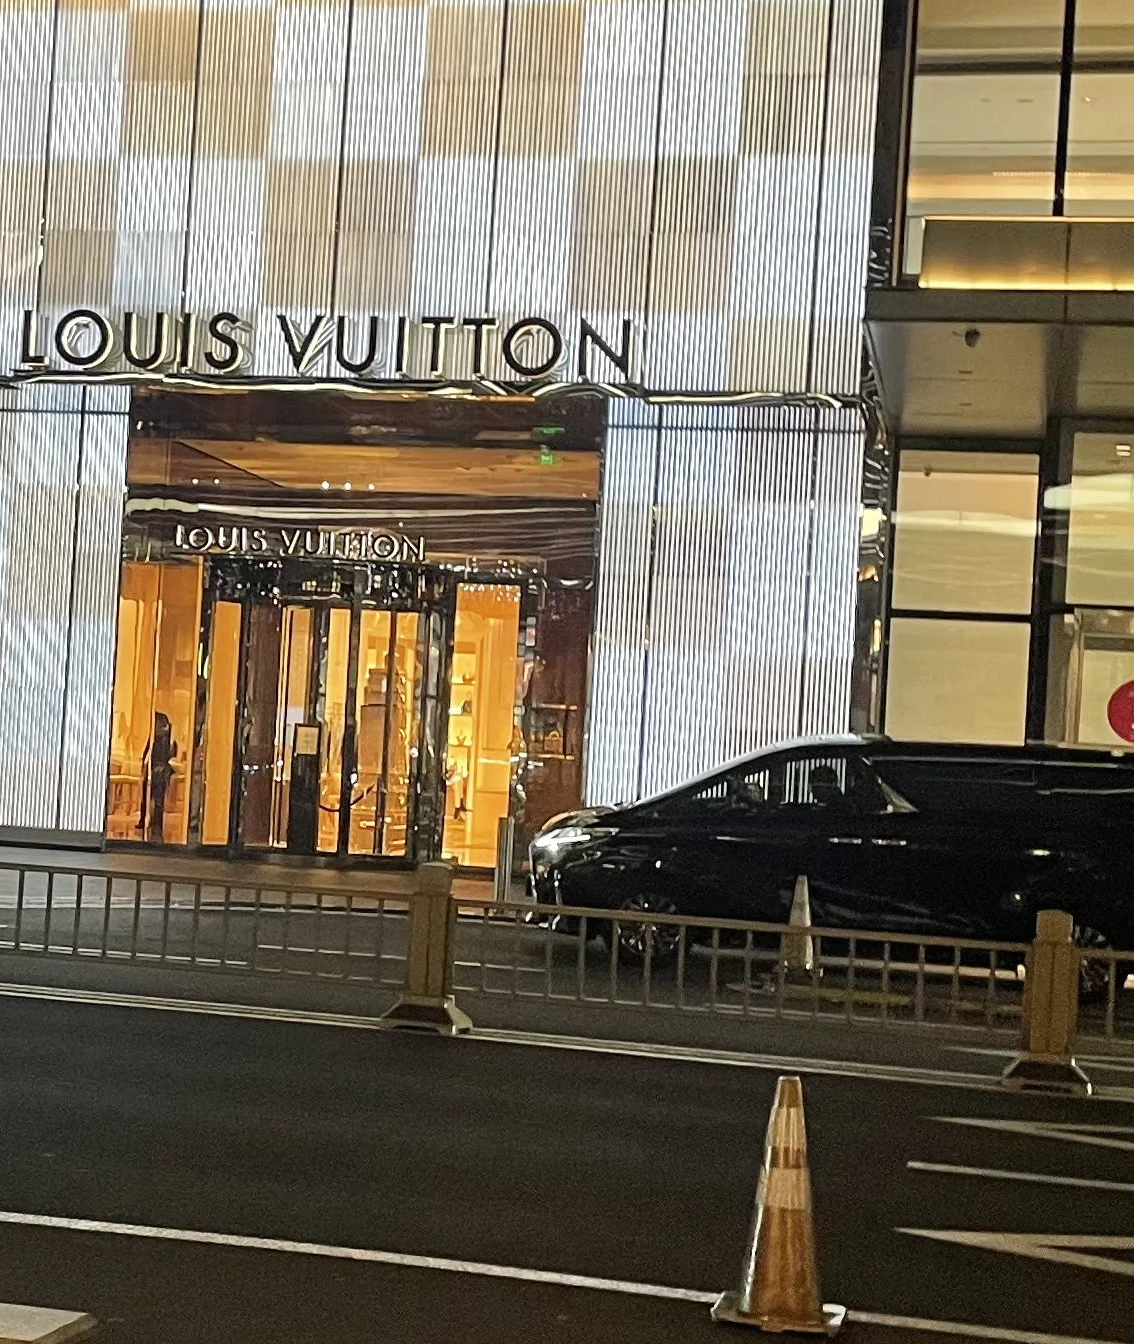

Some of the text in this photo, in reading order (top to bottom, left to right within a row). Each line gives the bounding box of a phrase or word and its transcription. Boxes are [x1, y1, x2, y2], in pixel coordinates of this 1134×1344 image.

[20, 308, 641, 384] LOUIS VUITTON
[175, 523, 426, 562] LOUIS VUITTON
